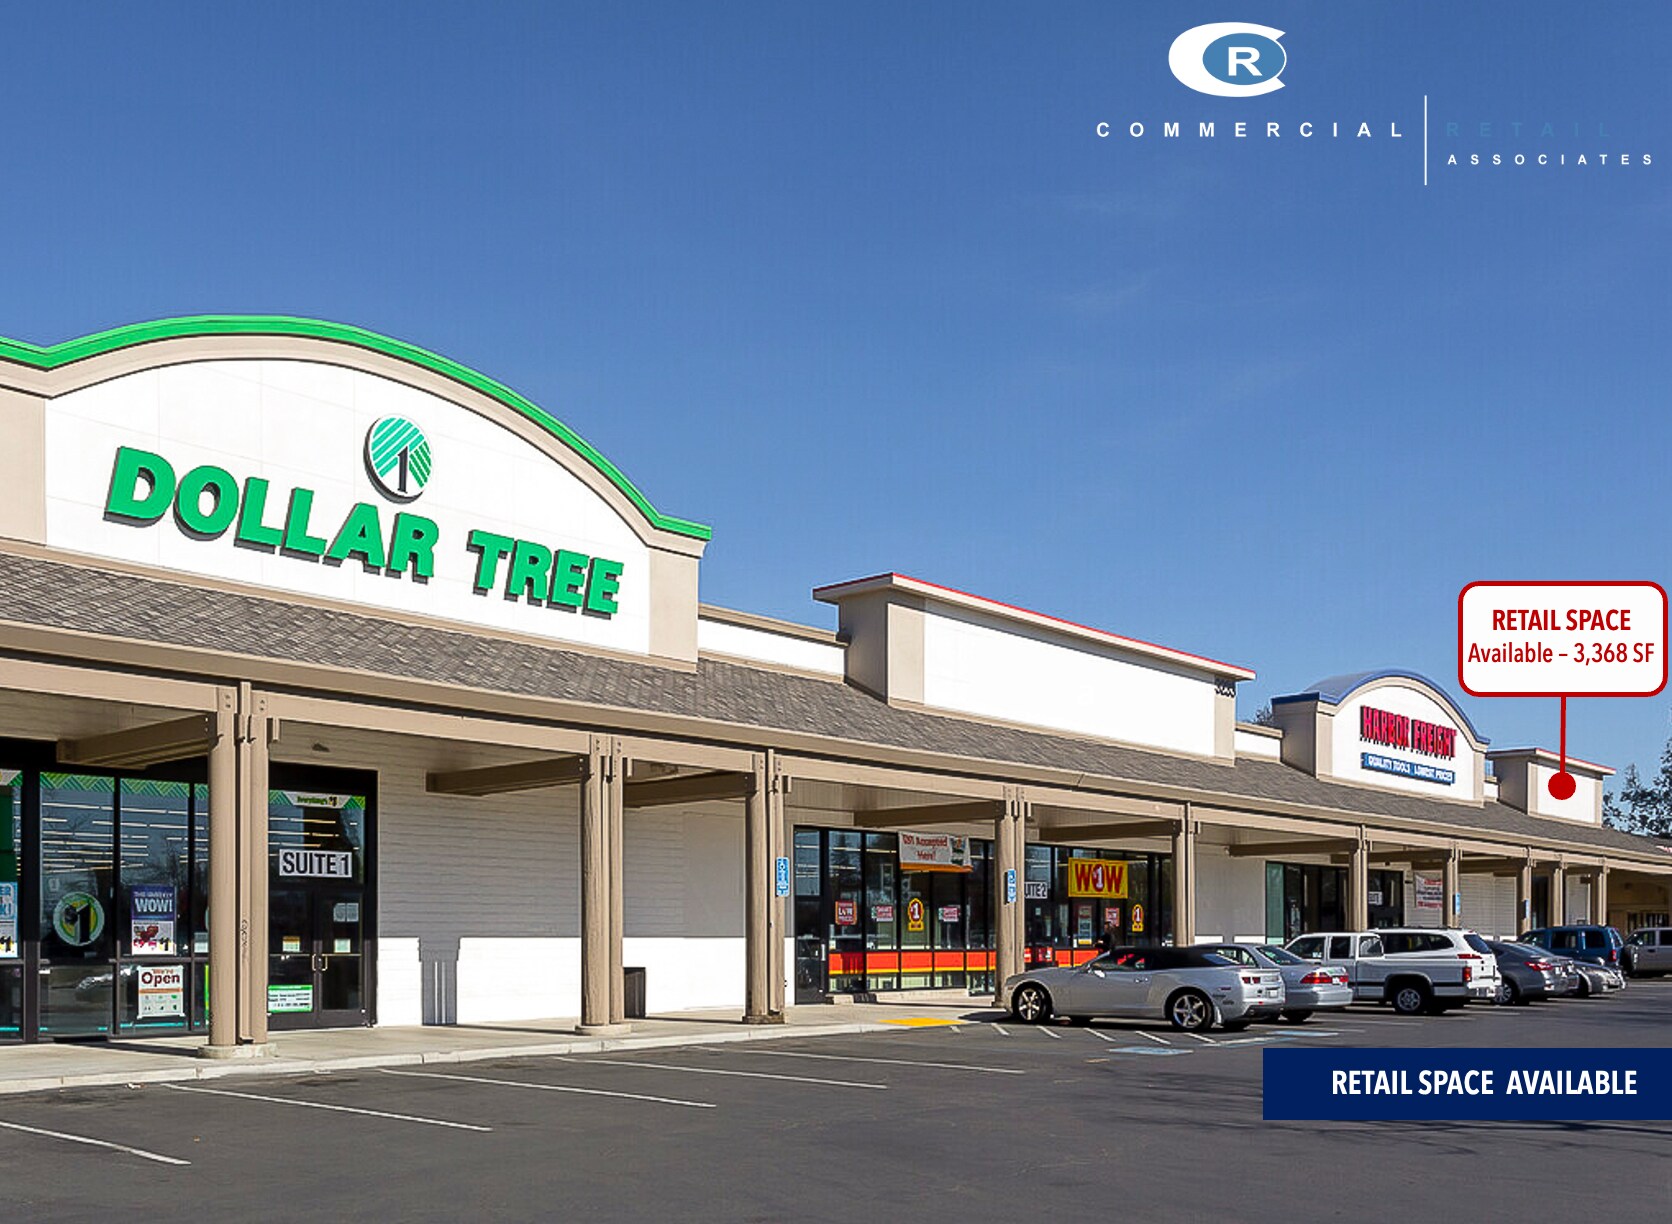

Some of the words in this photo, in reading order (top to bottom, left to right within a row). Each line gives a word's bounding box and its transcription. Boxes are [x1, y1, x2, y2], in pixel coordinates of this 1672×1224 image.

[103, 446, 439, 584] DOLLAR
[467, 529, 625, 620] TREE
[1360, 704, 1411, 751] HARBOR
[1410, 718, 1458, 761] FREIGHT
[282, 852, 338, 875] SUITE
[340, 854, 349, 875] 1
[141, 971, 180, 987] Open
